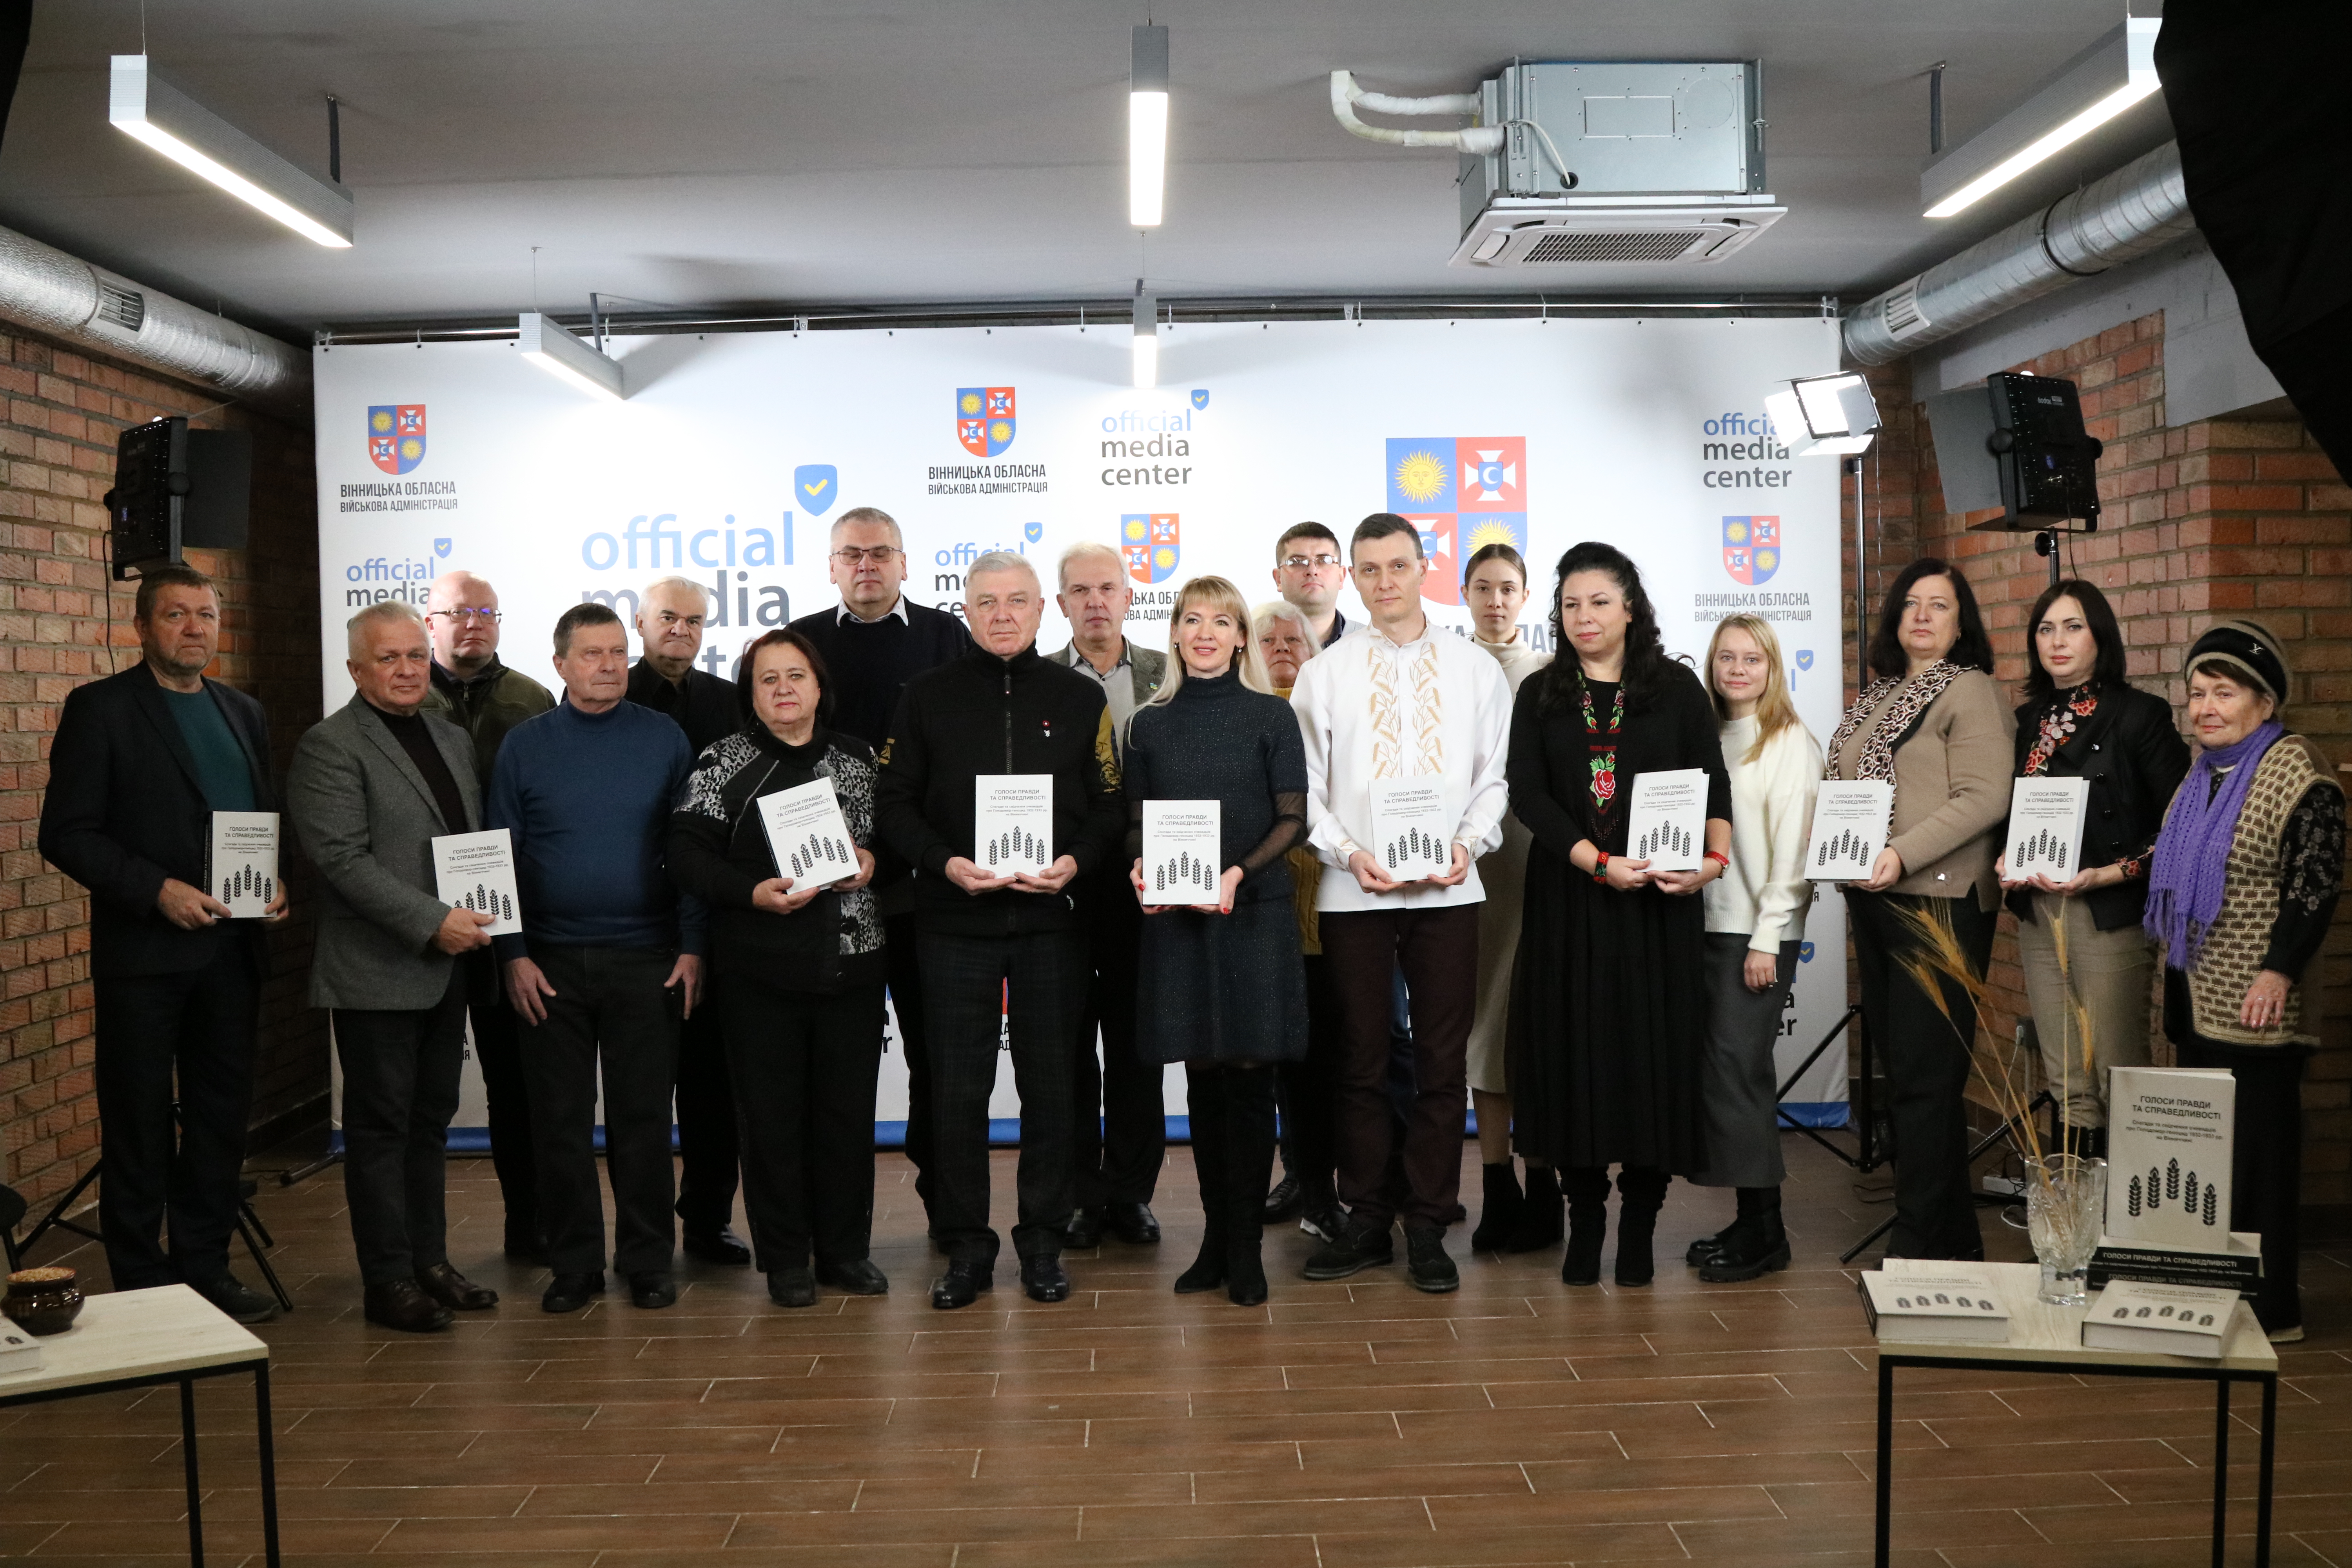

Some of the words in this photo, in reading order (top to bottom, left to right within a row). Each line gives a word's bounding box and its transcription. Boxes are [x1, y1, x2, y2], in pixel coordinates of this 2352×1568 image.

[1102, 408, 1191, 433] official
[1704, 412, 1777, 436] offici
[1102, 433, 1189, 458] media
[1704, 436, 1789, 460] media
[929, 466, 991, 480] ВІННИЦЬКА
[994, 464, 1046, 478] ОБЛАСНА
[1101, 464, 1192, 486] center
[1703, 466, 1792, 488] center
[340, 483, 402, 498] ВІННИЦЬКА
[405, 481, 456, 495] ОБЛАСНА
[928, 483, 976, 495] ВІЙСЬКОВА
[979, 482, 1047, 494] АДМІНІСТРАЦІЯ
[340, 499, 388, 512] ВІЙСЬКОВА
[390, 499, 458, 512] АДМІНІСТРАЦІЯ
[582, 511, 794, 571] official
[347, 557, 434, 582] official
[347, 581, 431, 606] media
[582, 570, 790, 630] mdia
[1695, 593, 1756, 608] ВІННИЦЬКА
[1759, 592, 1810, 606] ОБЛАСНА
[1694, 610, 1741, 622] ВІЙСЬК
[780, 801, 800, 810] ГОЛОСИ
[802, 794, 822, 804] ПРАВДИ
[785, 798, 830, 815] СПРАВЕДЛИВОСТІ
[457, 851, 505, 860] СПРАВЕДЛИВОСТІ
[2140, 1096, 2174, 1105] ГОЛОСИ
[2177, 1099, 2210, 1109] ПРАВДИ
[2145, 1106, 2220, 1120] СПРАВЕДЛИВОСТІ
[2173, 1258, 2237, 1267] СПРАВЕДЛИВОСТІ
